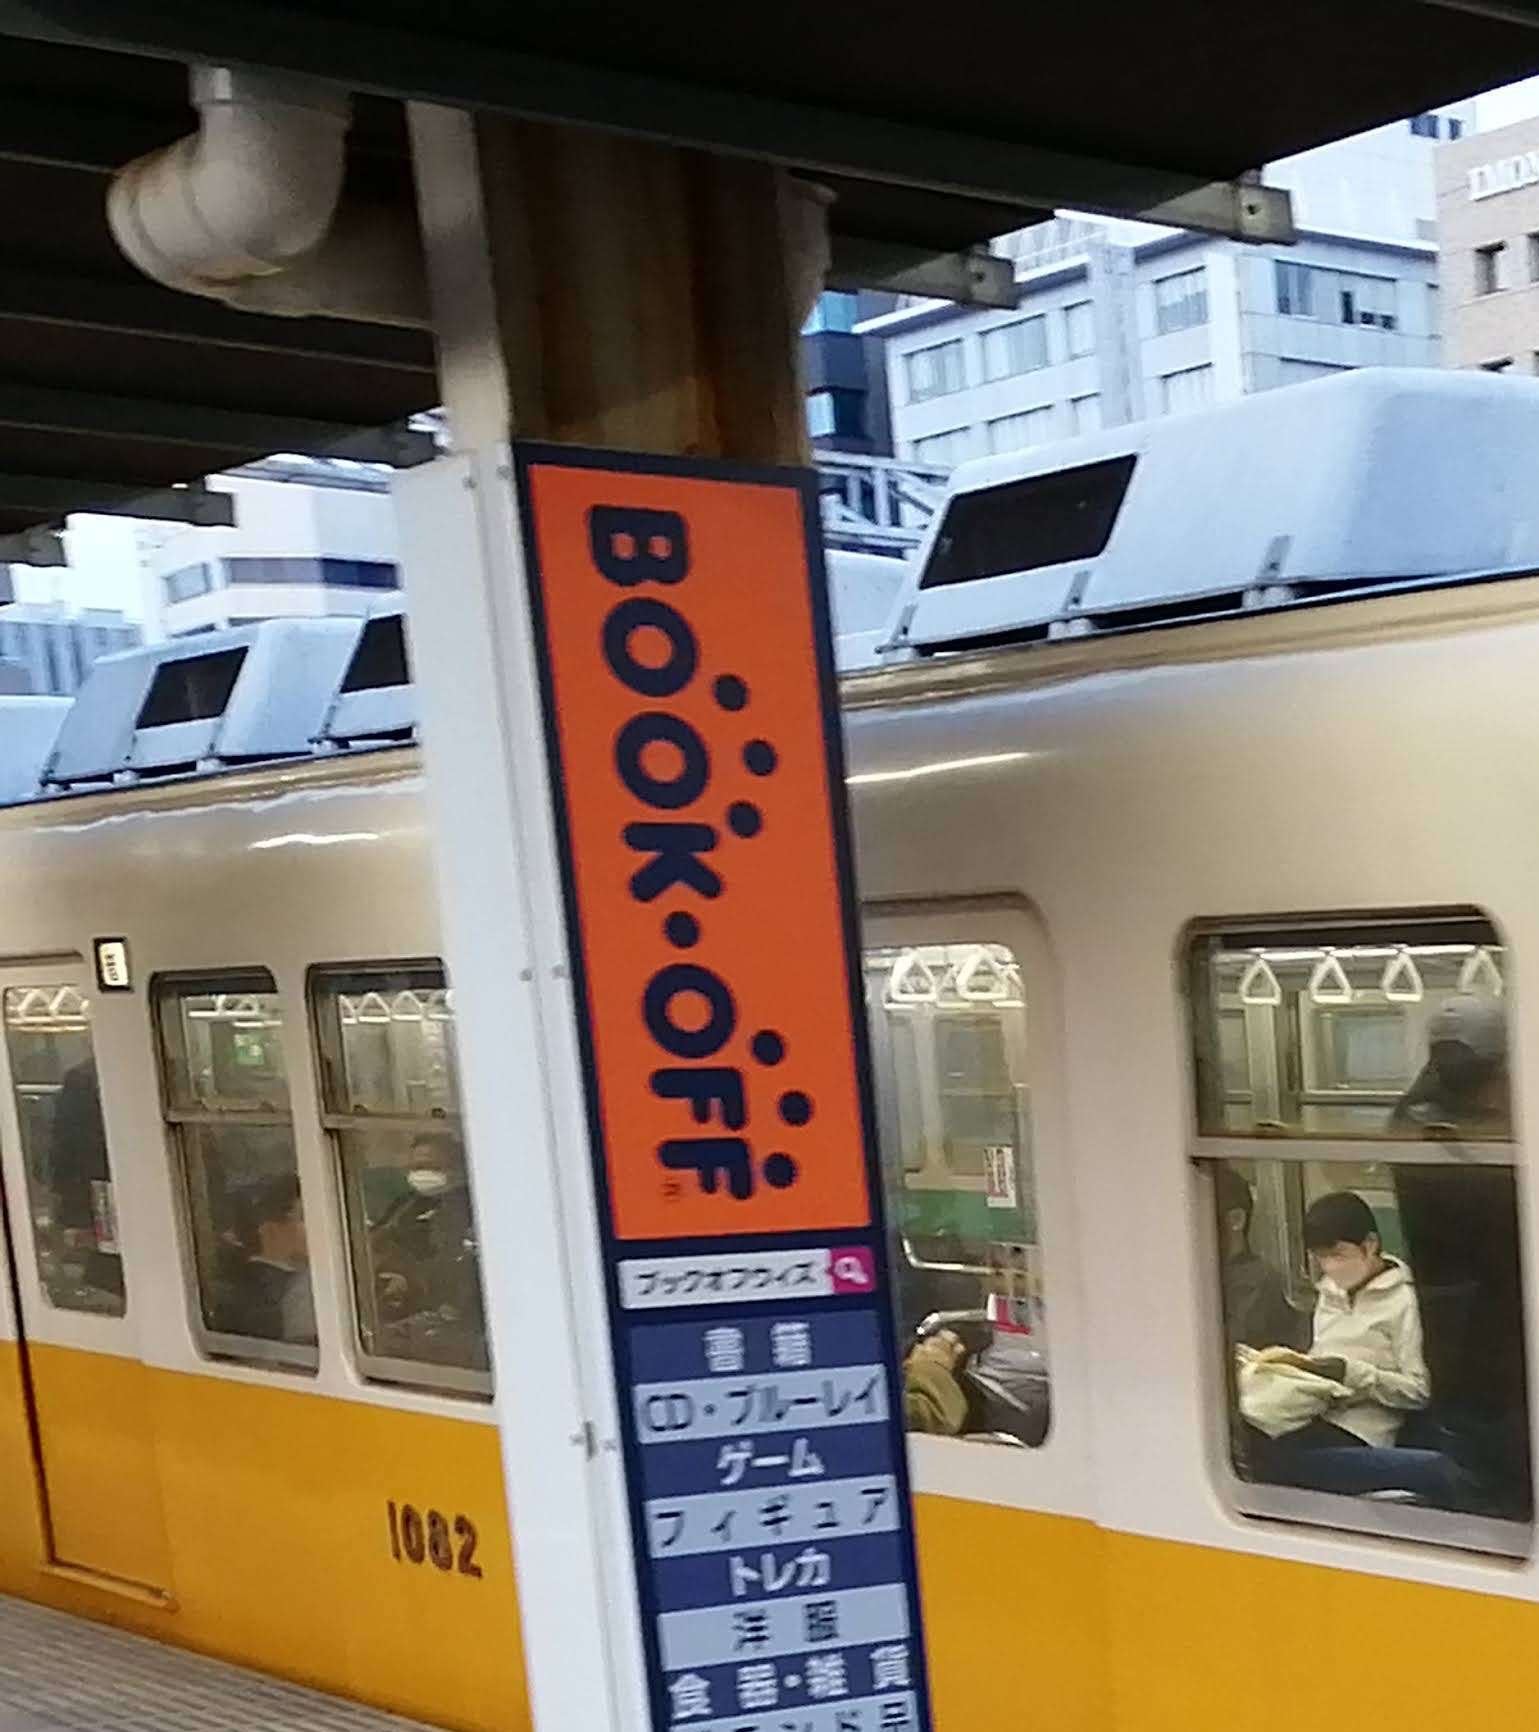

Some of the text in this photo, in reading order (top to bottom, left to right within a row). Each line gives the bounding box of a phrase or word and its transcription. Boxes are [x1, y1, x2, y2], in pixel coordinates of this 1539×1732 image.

[715, 1437, 826, 1486] ゲーム
[387, 1499, 483, 1579] 1082
[656, 1487, 888, 1548] フィギュア
[729, 1547, 832, 1597] トレカ
